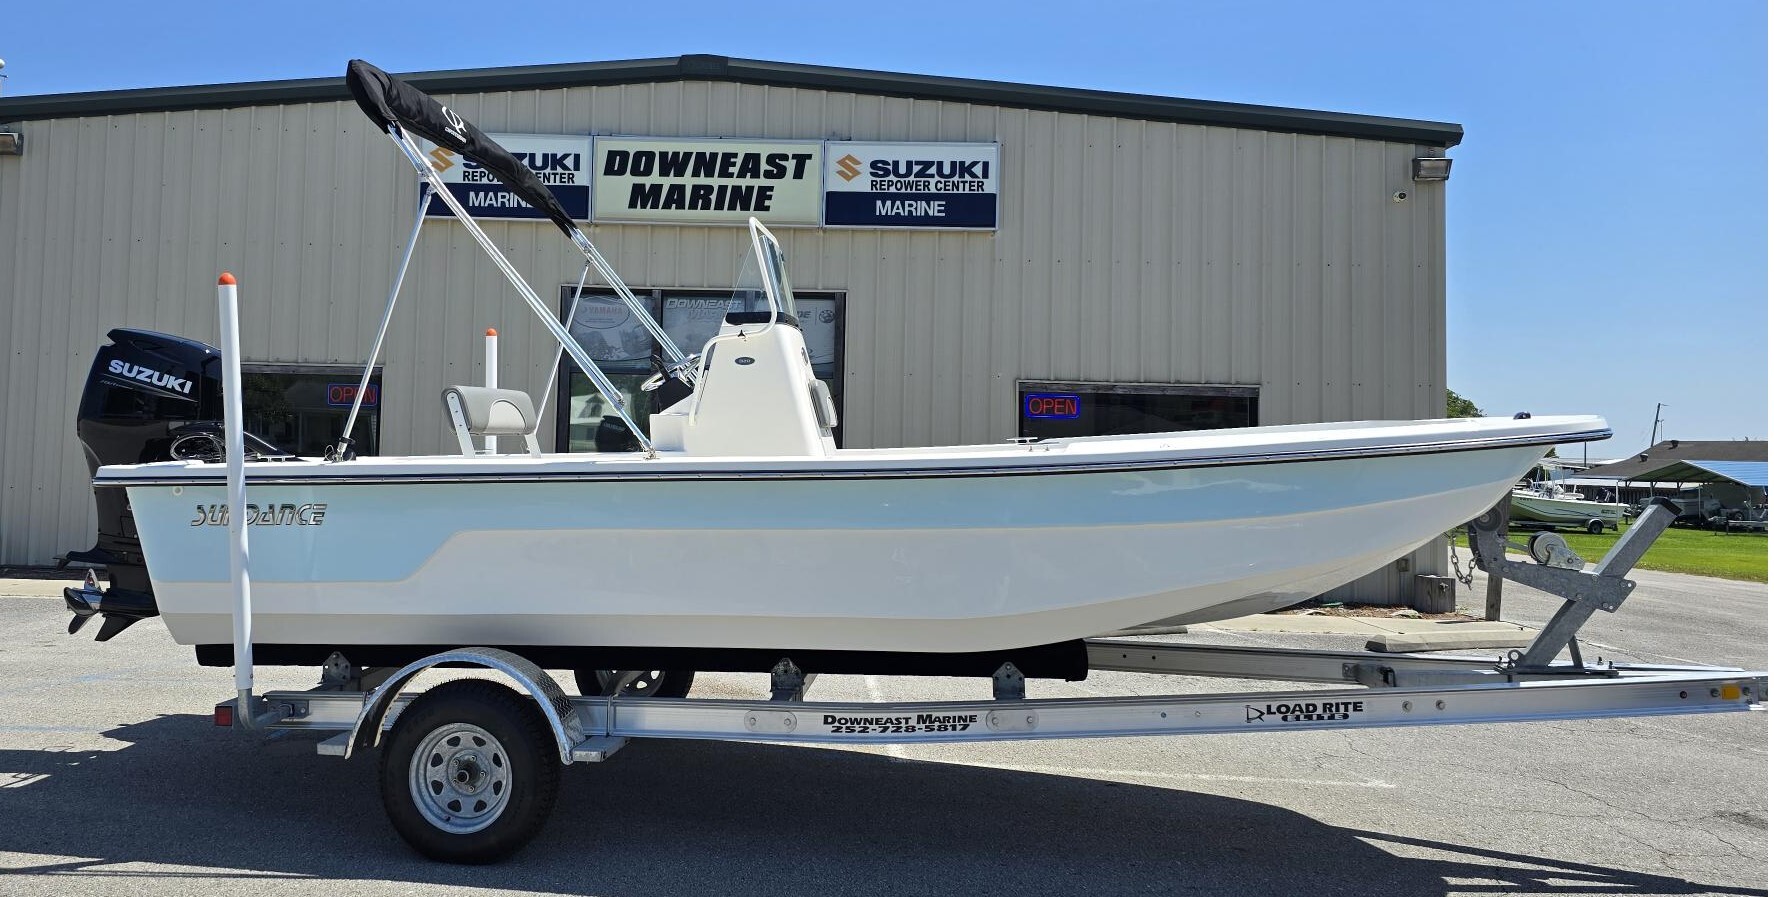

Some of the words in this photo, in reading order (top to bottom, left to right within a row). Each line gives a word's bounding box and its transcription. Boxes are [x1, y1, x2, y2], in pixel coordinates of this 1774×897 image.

[604, 150, 813, 180] DOWNEAST
[869, 159, 990, 180] SUZUKI
[535, 172, 576, 184] ENTER
[870, 179, 931, 192] REPOWER
[934, 181, 985, 192] CENTER
[628, 183, 775, 212] MARINE
[875, 200, 946, 217] MARINE
[108, 360, 193, 394] SUZUKI
[1028, 398, 1077, 415] OPEN
[191, 504, 327, 526] SUDANCE
[1266, 703, 1318, 715] LOAD
[1322, 701, 1364, 713] RITE
[823, 714, 912, 725] DOWNEAST
[916, 714, 978, 724] MARINE
[1284, 713, 1346, 721] ELITE
[831, 723, 971, 733] 252-728-5817
